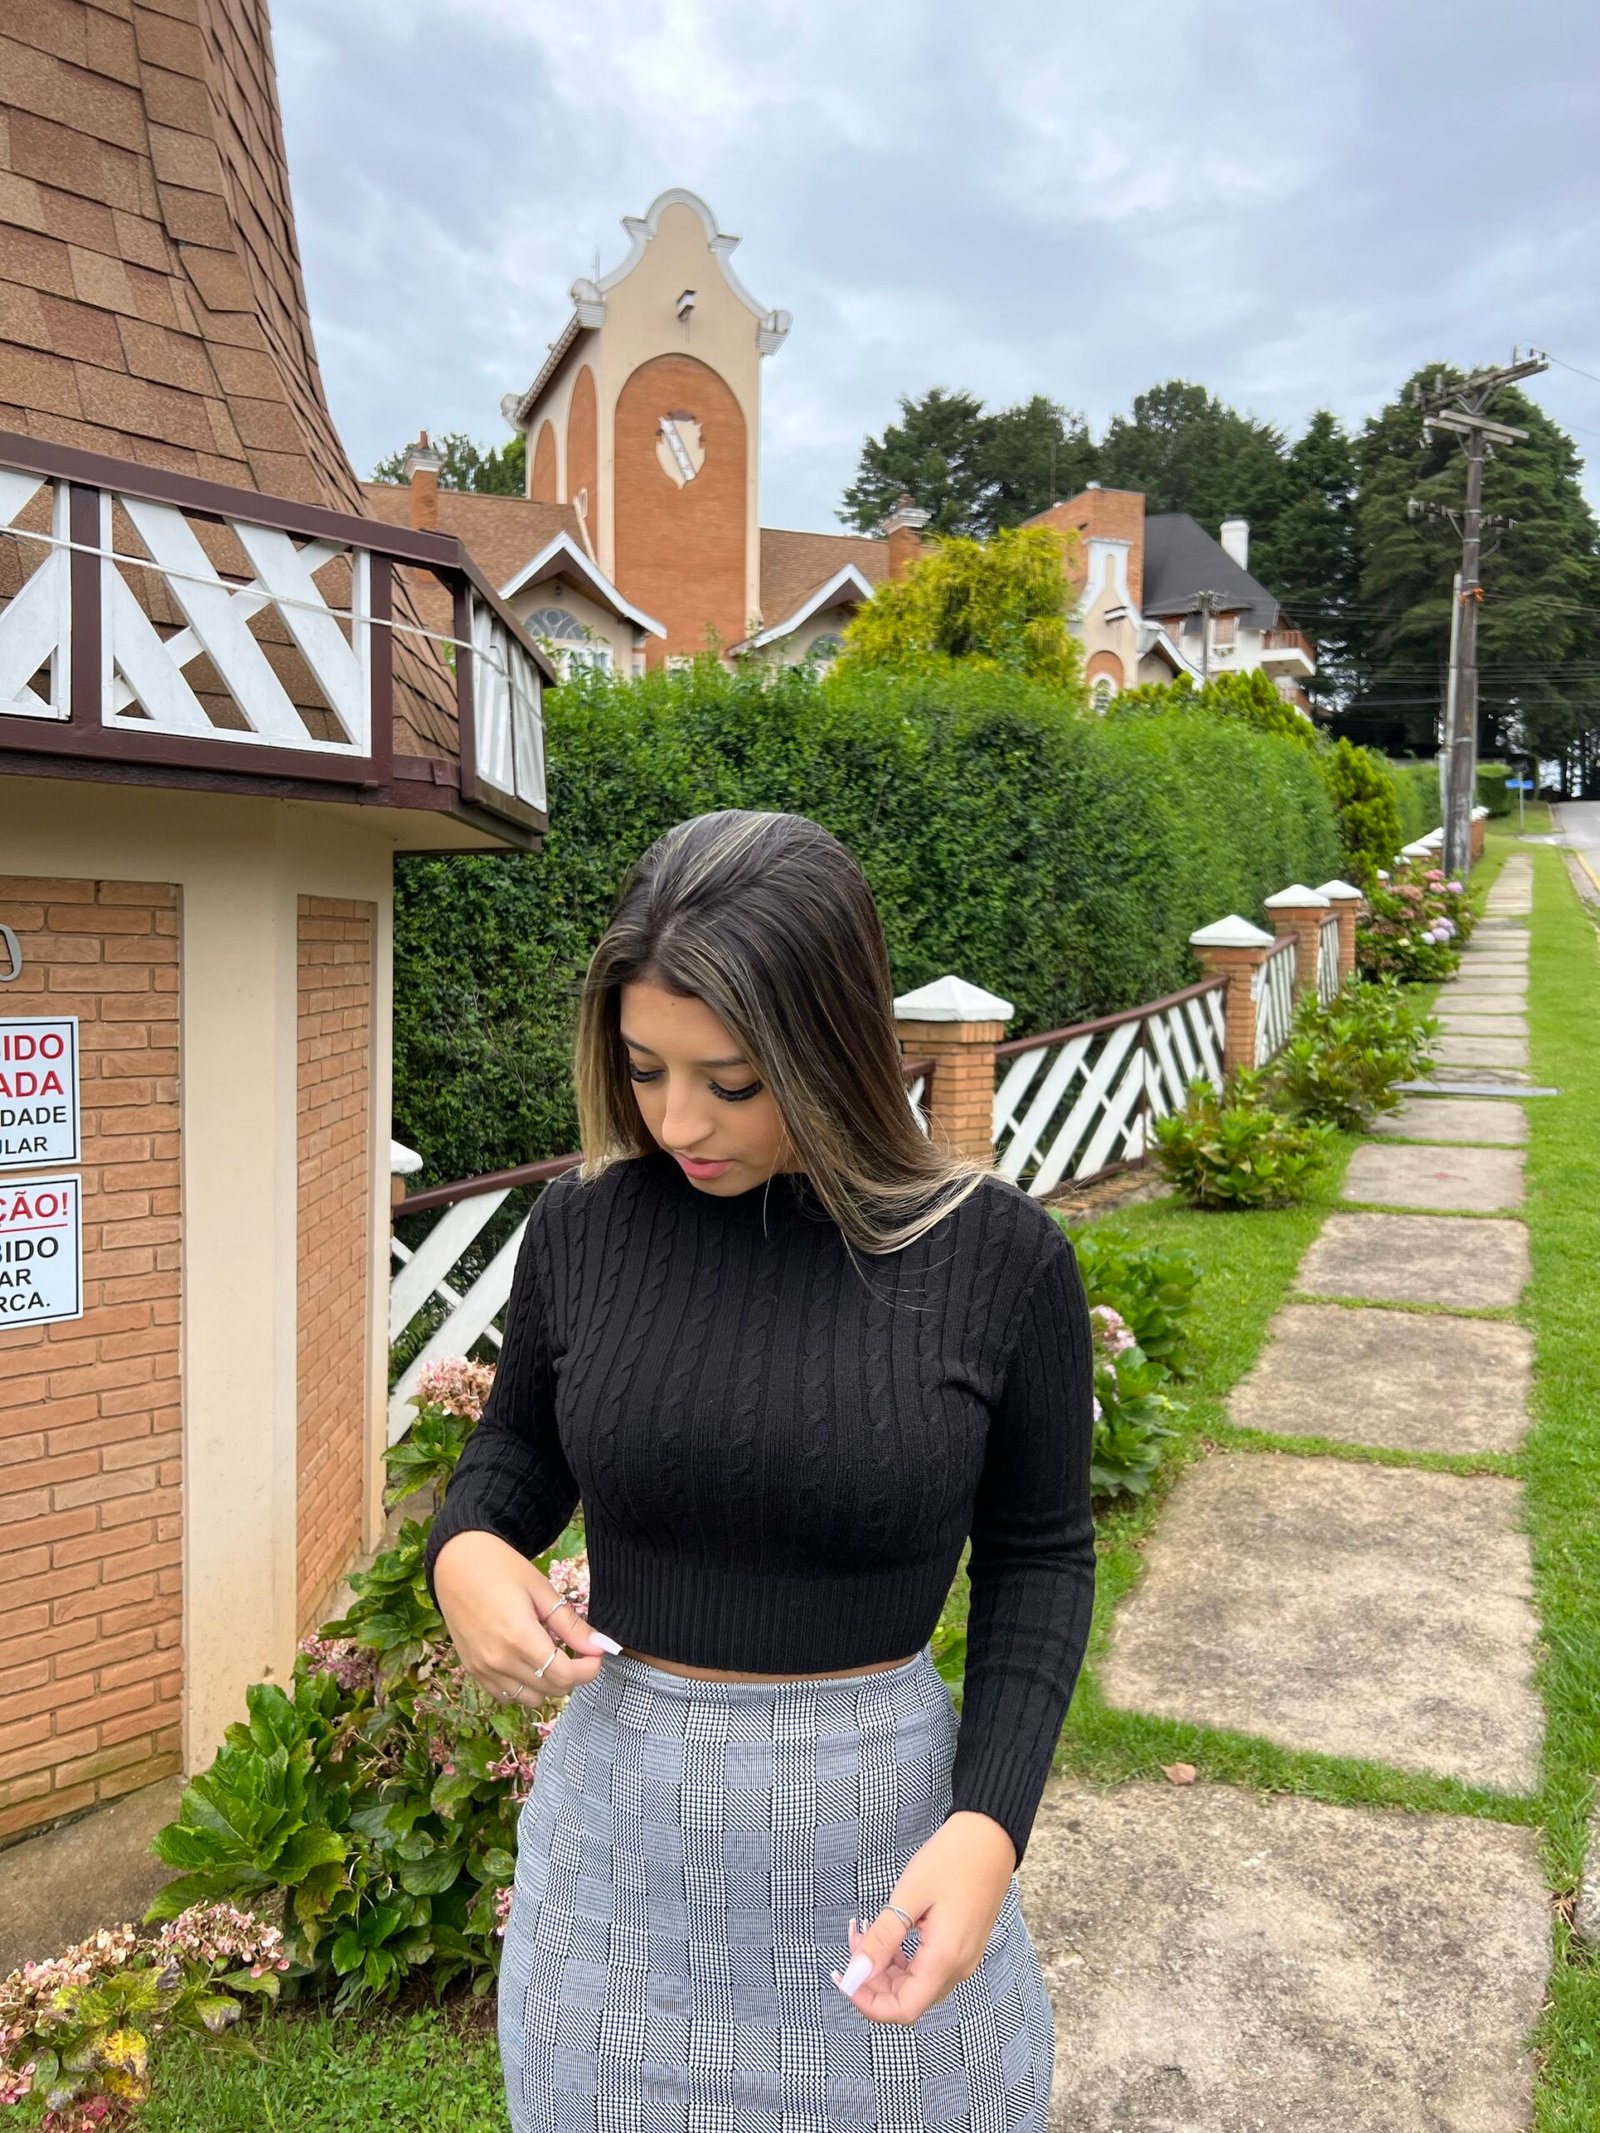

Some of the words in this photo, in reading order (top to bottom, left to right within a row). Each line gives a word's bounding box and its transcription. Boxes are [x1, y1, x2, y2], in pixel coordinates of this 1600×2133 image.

[1, 1106, 66, 1127] DADE
[0, 1137, 48, 1155] LAR
[0, 1236, 59, 1263] IDO
